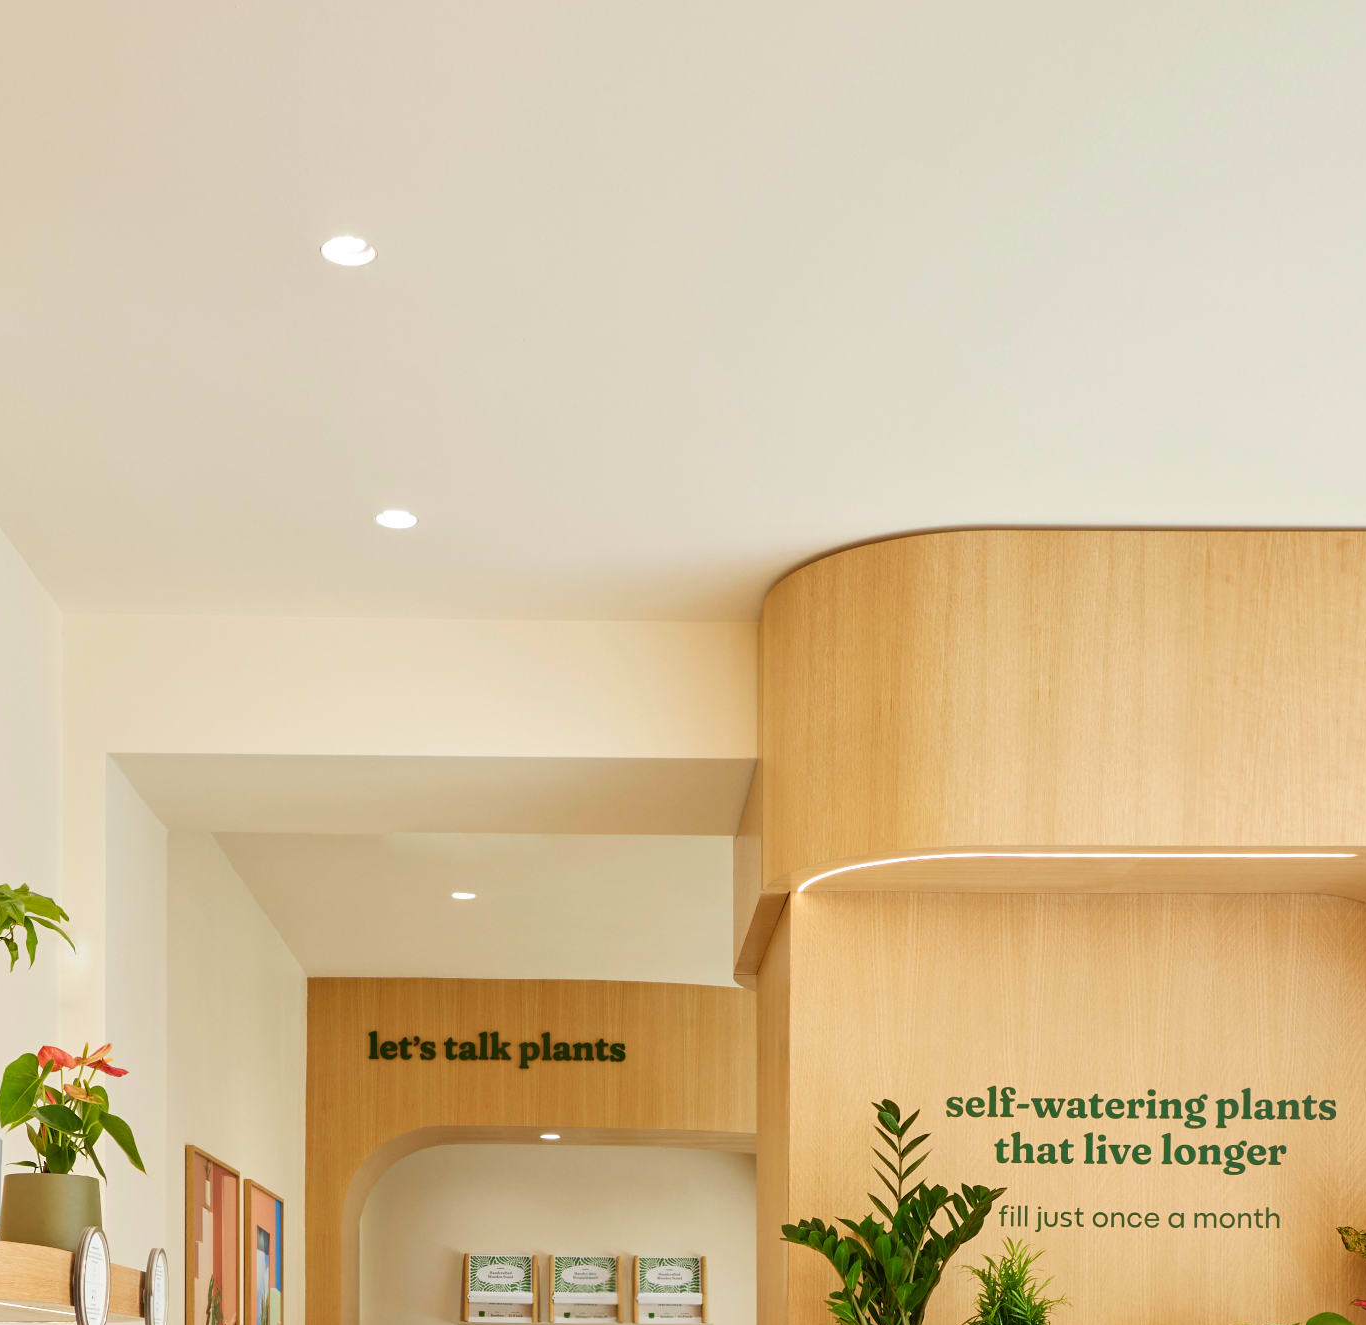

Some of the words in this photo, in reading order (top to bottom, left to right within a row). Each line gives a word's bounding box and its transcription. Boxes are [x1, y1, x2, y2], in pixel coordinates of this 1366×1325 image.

[368, 1030, 437, 1061] let's
[444, 1031, 512, 1062] talk
[519, 1031, 627, 1069] plants
[945, 1085, 1209, 1129] self-watering
[1215, 1087, 1338, 1129] plants
[993, 1131, 1075, 1165] that
[1083, 1132, 1153, 1165] live
[1161, 1132, 1288, 1176] longer
[998, 1204, 1029, 1228] fill
[1035, 1206, 1085, 1233] just
[1092, 1210, 1161, 1229] once
[1167, 1212, 1186, 1229] a
[1193, 1206, 1281, 1229] month
